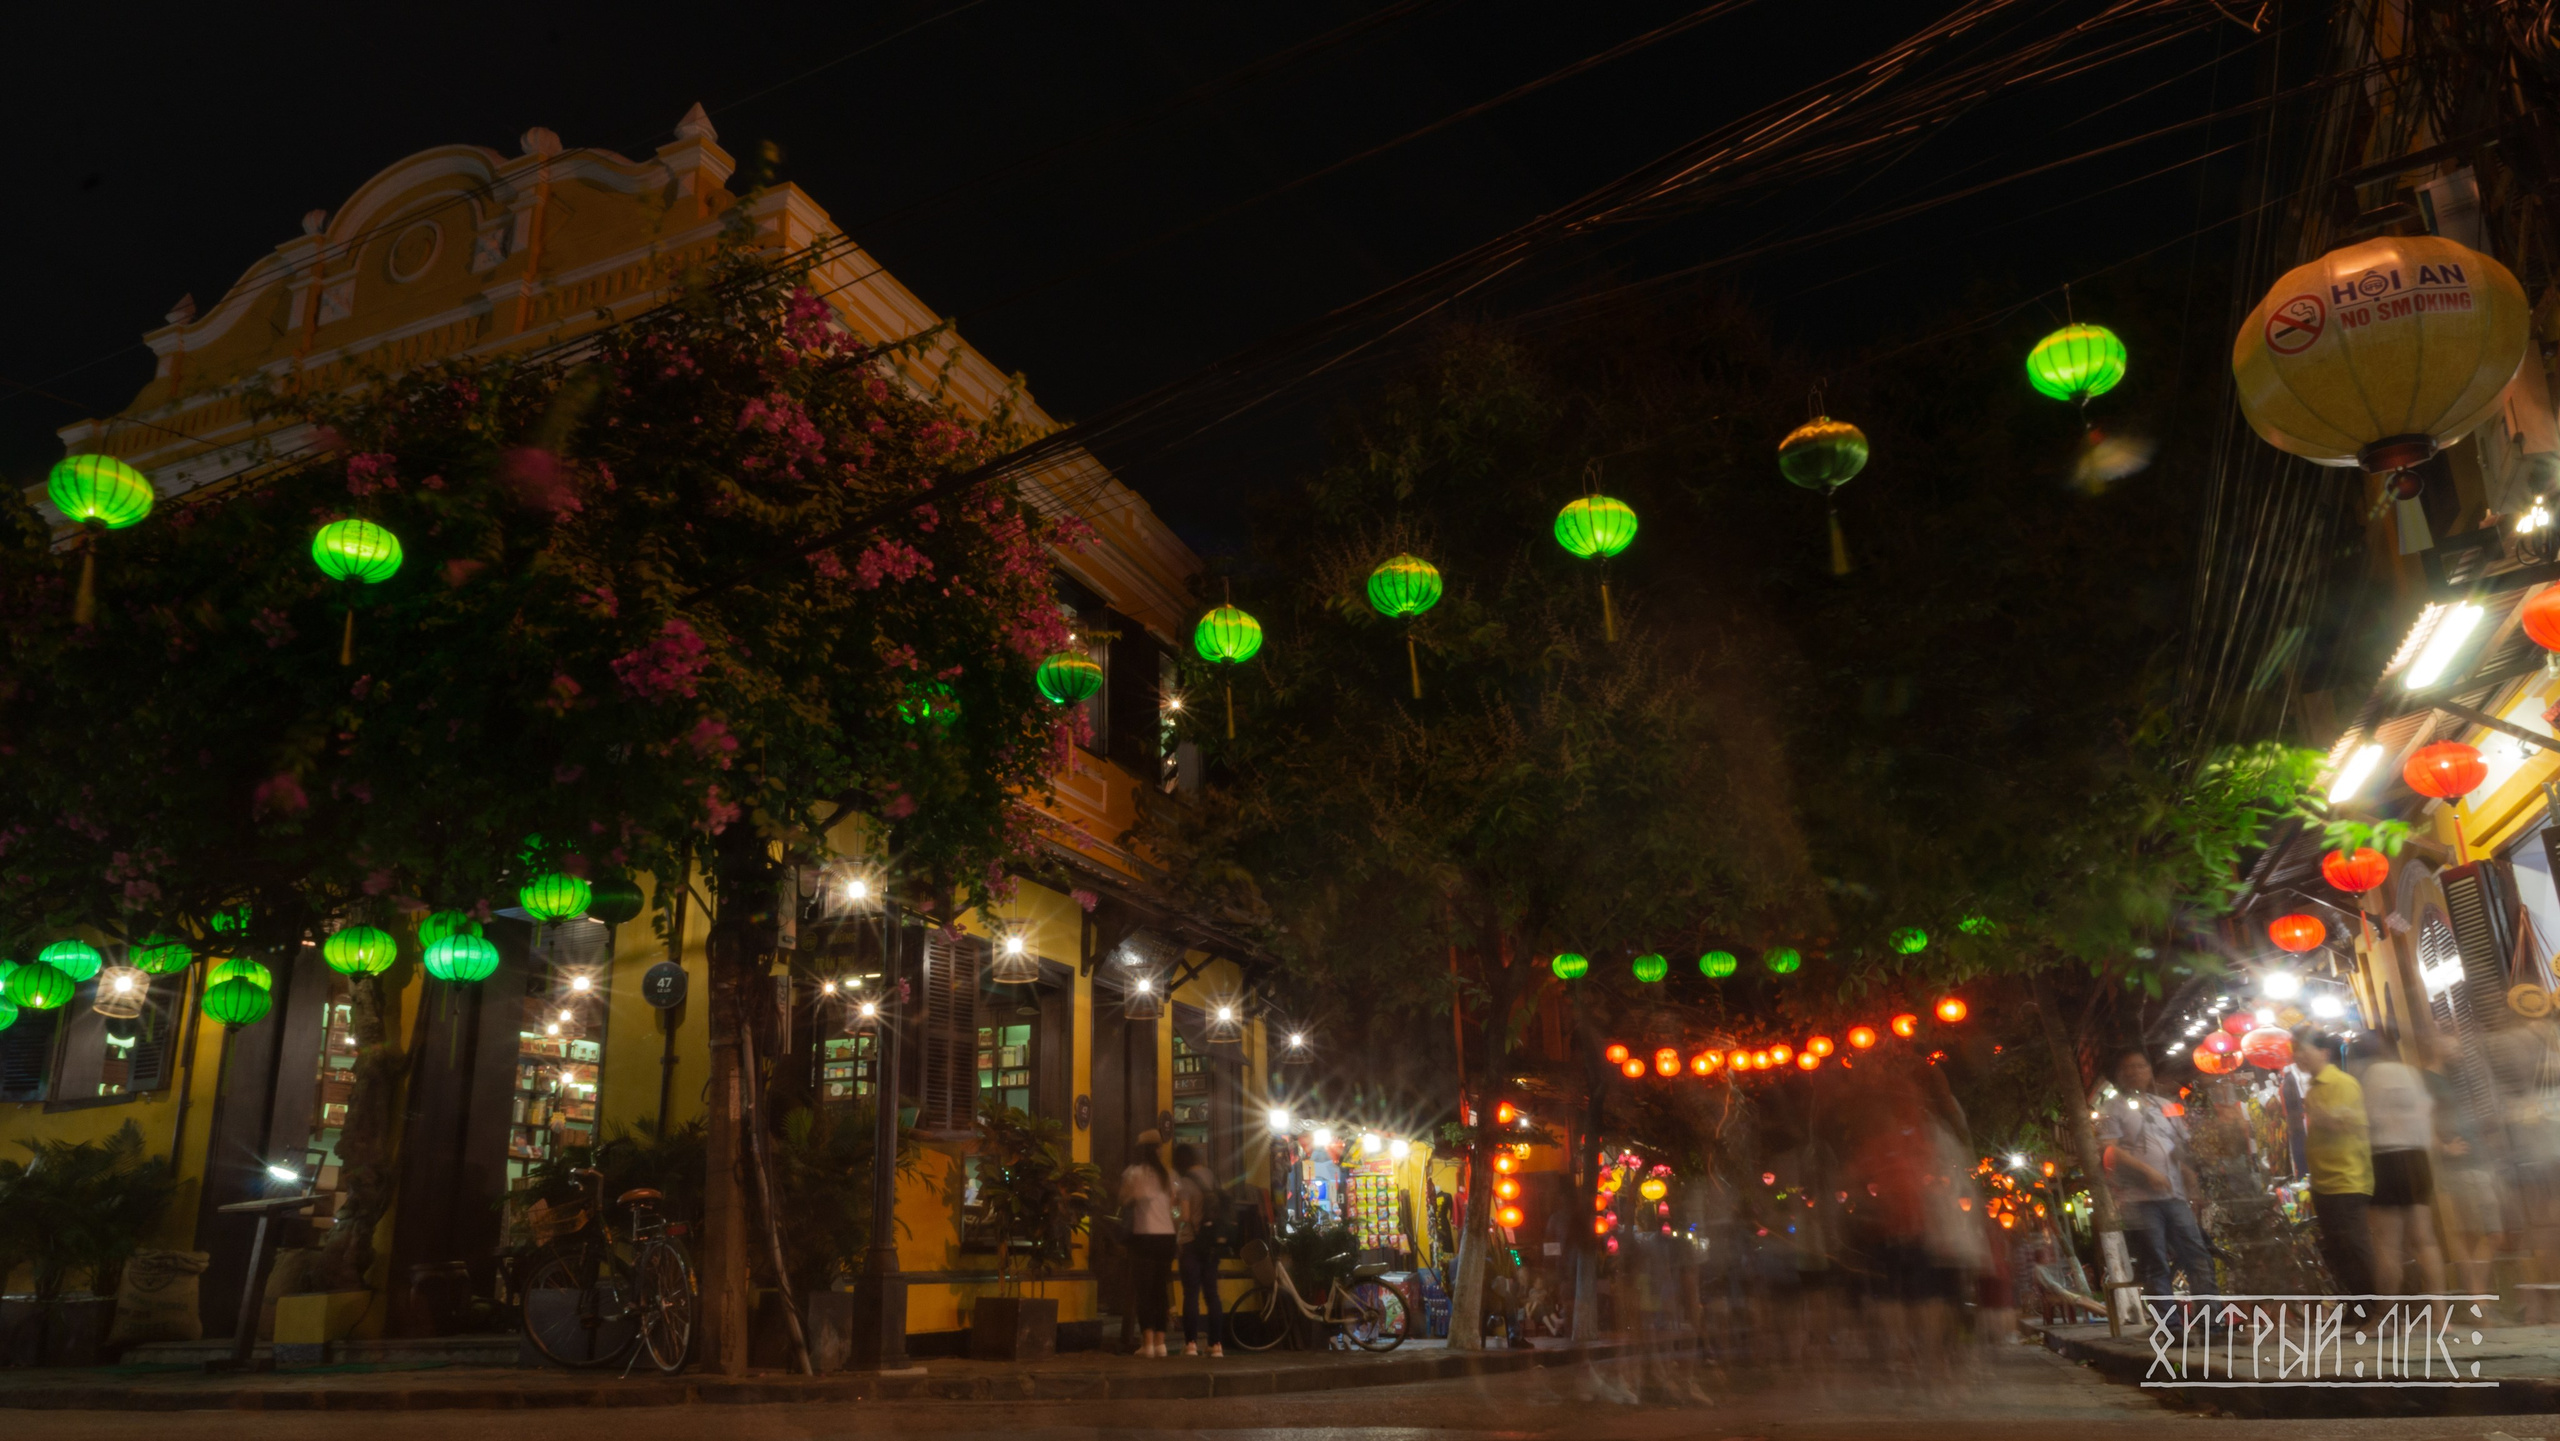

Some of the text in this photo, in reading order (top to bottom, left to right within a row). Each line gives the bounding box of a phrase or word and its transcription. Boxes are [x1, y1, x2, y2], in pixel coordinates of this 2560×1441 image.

[2419, 264, 2466, 284] AN
[2340, 292, 2471, 329] NO SMOKING
[656, 977, 673, 988] 47
